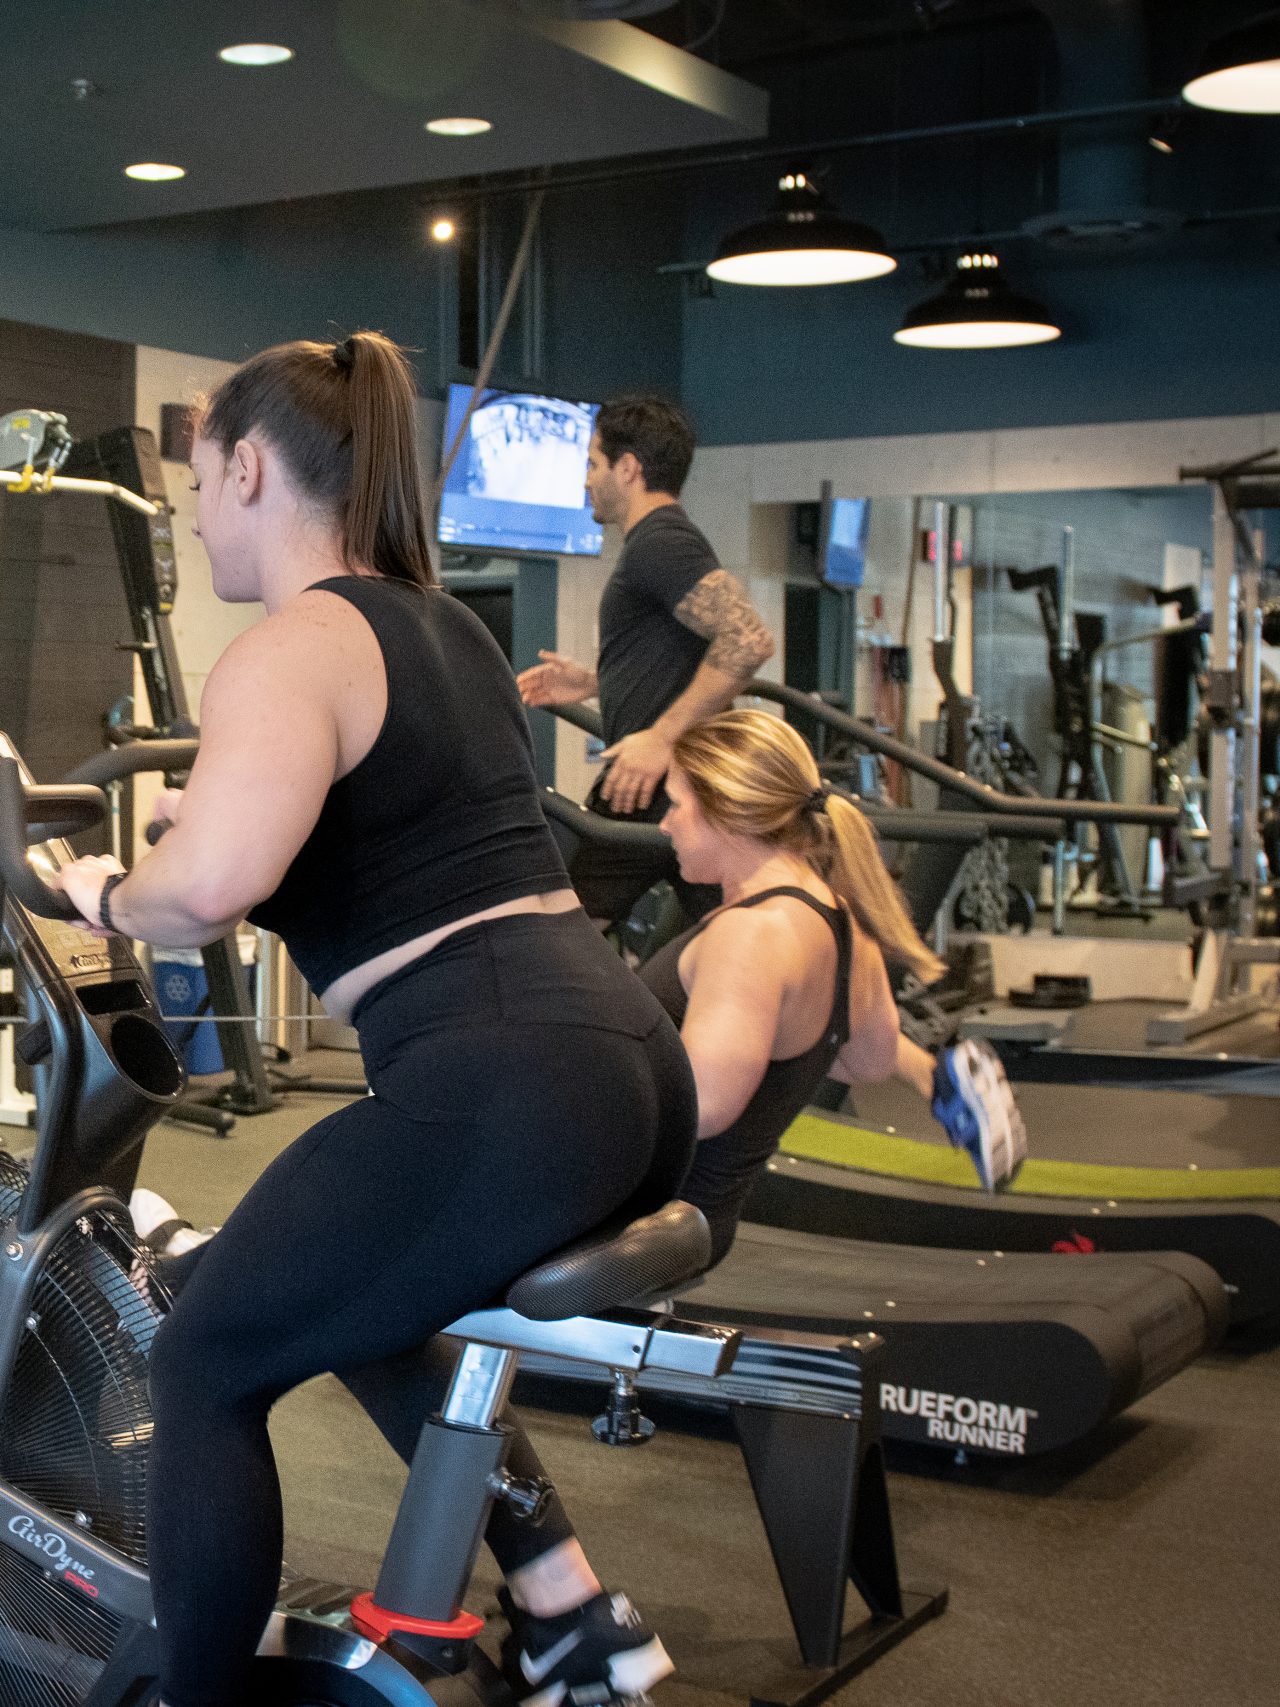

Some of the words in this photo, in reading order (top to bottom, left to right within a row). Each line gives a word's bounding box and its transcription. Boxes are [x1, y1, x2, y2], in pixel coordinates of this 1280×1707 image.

[879, 1382, 1028, 1435] RUEFORM
[927, 1418, 1026, 1456] RUNNER
[7, 1514, 96, 1581] AirDyne
[63, 1569, 100, 1599] PRO
